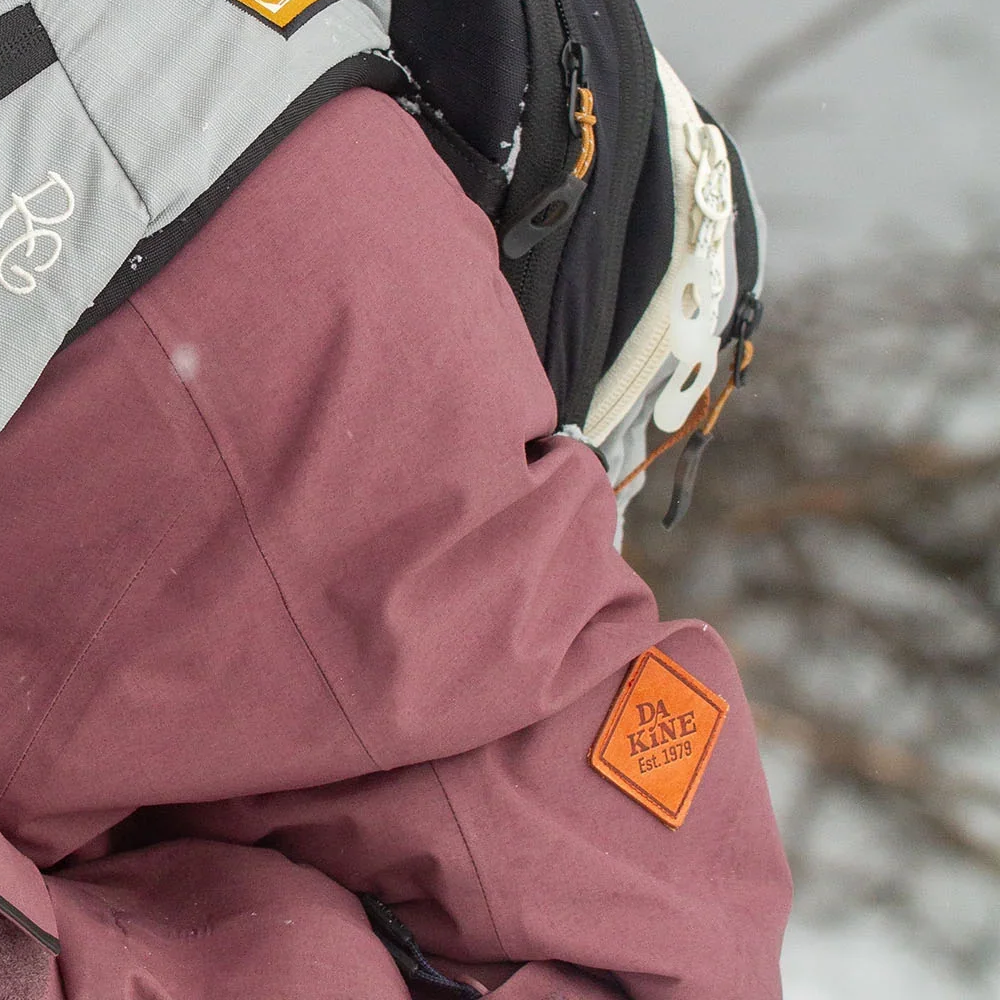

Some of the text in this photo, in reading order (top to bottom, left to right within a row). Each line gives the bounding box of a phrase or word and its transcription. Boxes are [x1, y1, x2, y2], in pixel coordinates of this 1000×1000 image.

[636, 699, 670, 731] DA
[638, 740, 693, 774] Est. 1979
